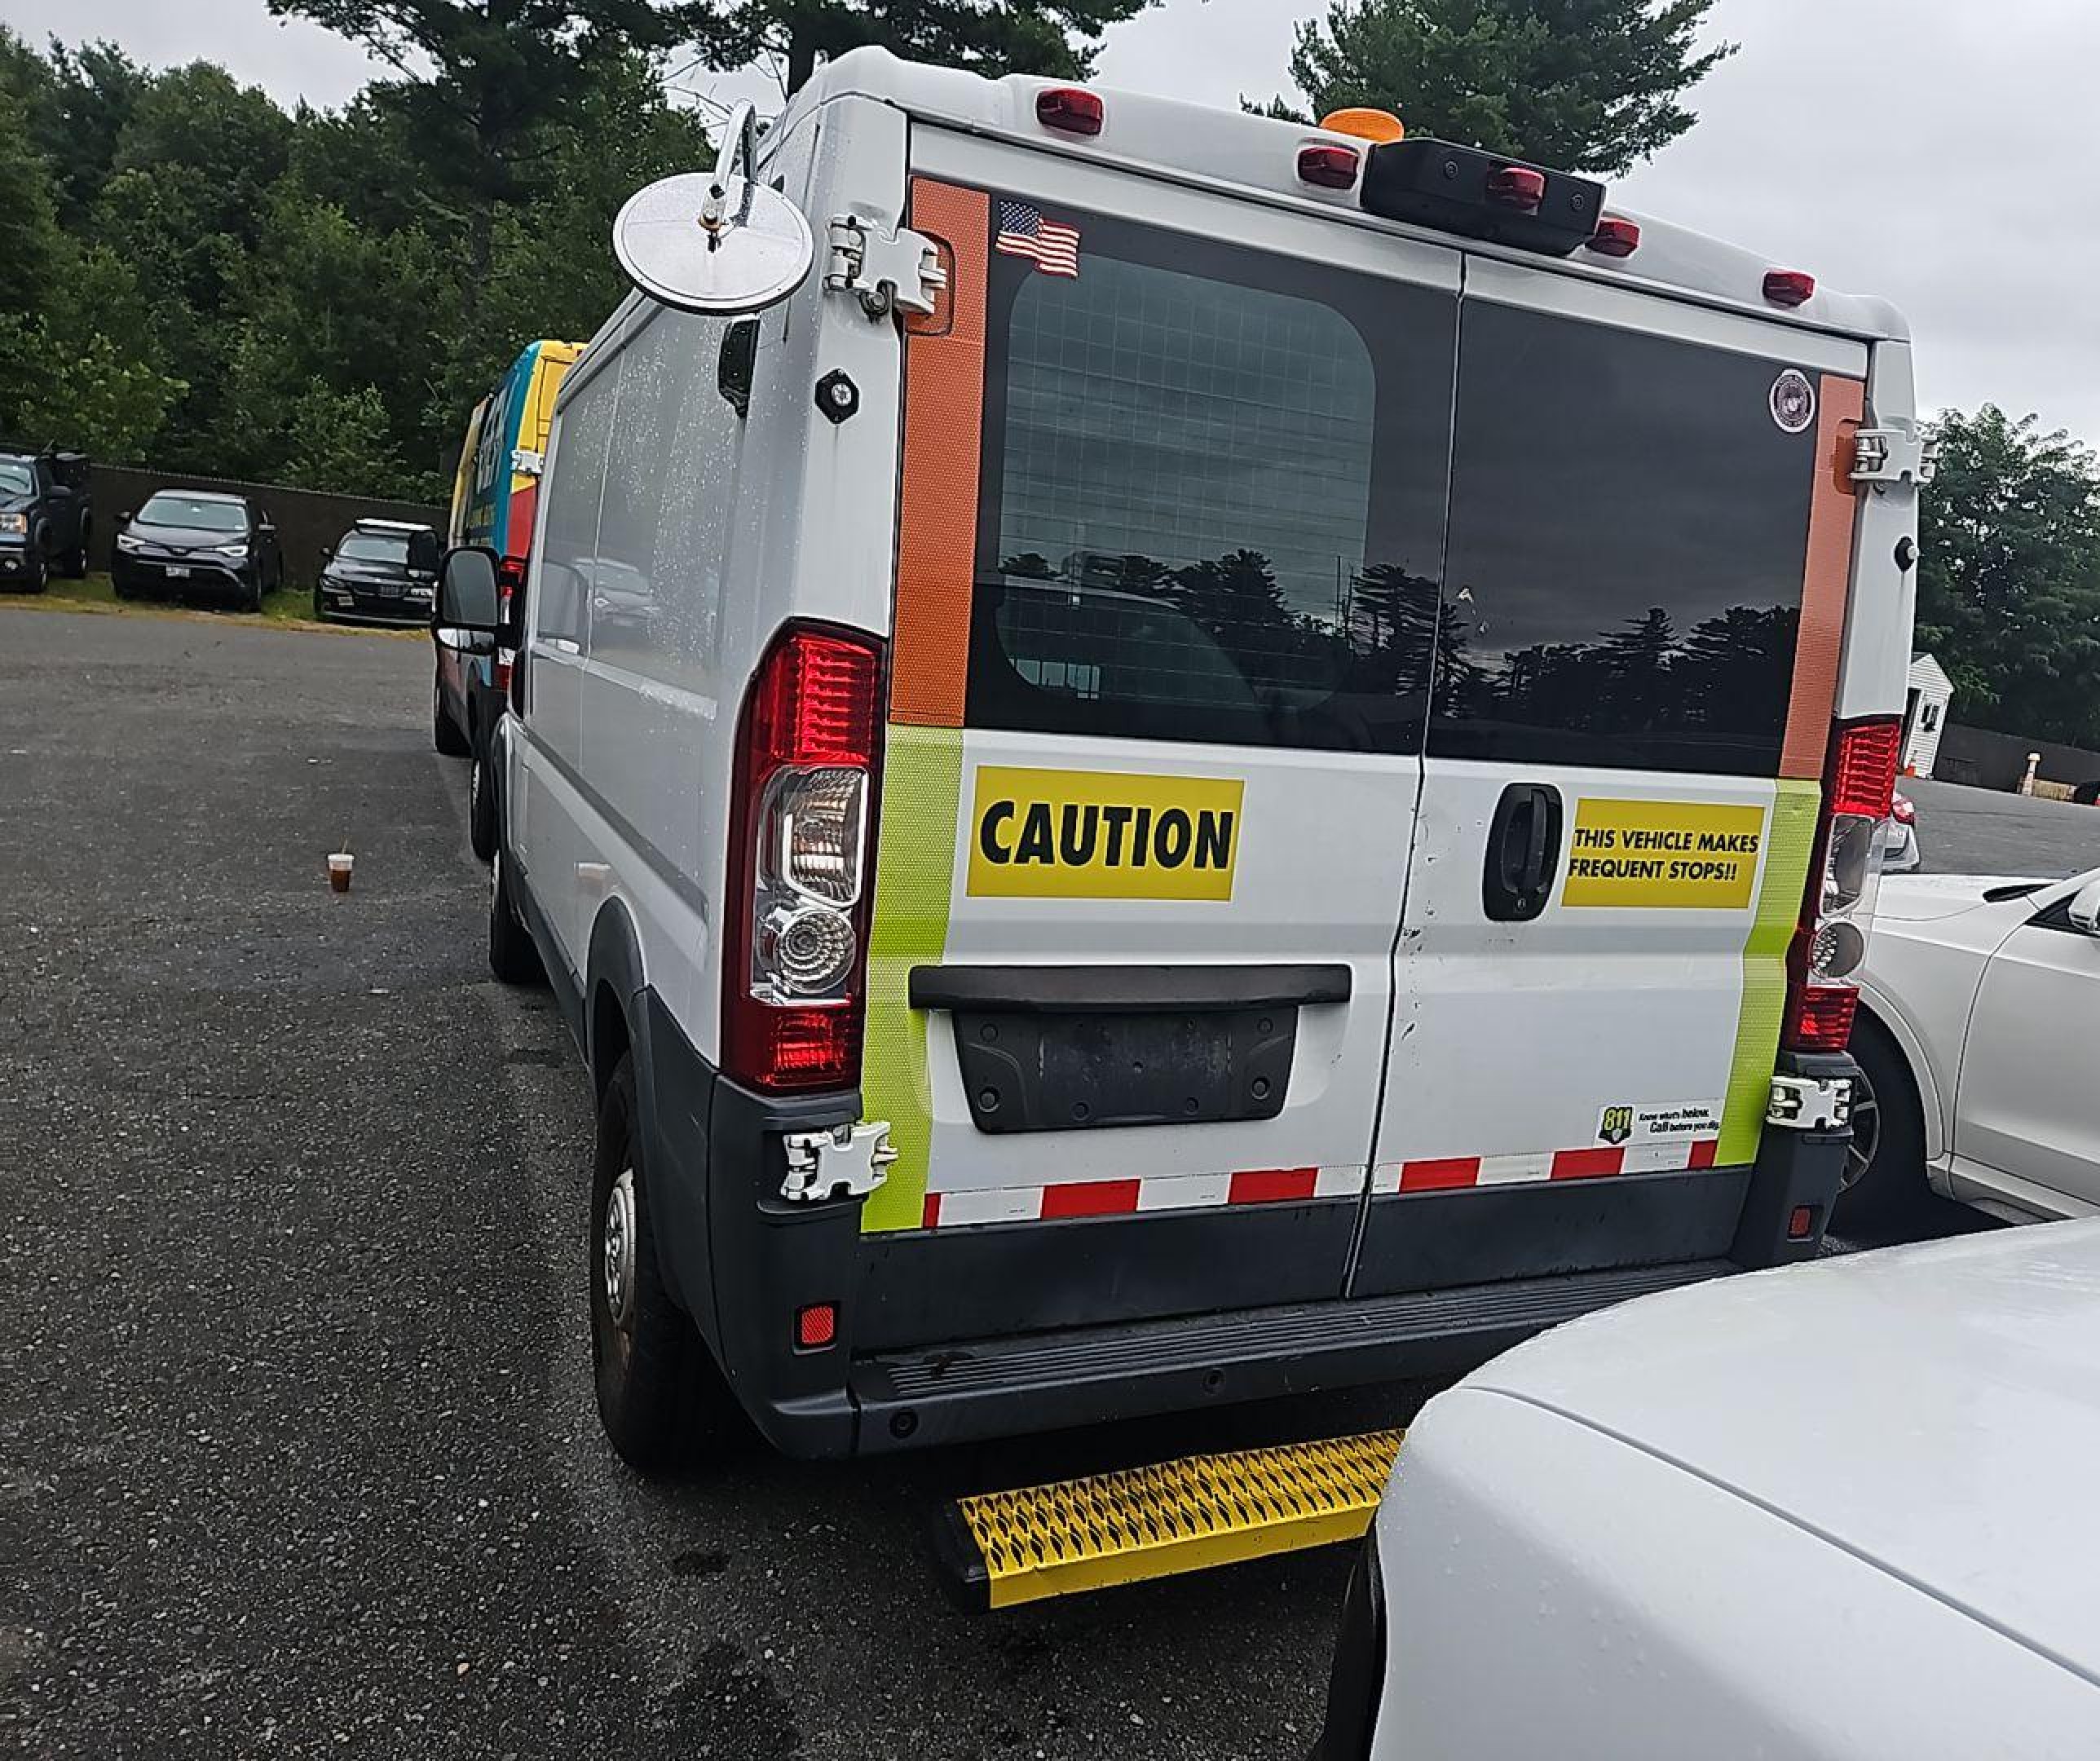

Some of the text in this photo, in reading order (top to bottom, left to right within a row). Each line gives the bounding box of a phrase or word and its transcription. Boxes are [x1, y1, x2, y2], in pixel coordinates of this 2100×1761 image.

[979, 800, 1233, 869] CAUTION
[1574, 828, 1759, 853] THIS VEHICLE MAKES
[1568, 858, 1737, 881] FREQUENT STOPS!!
[1604, 1109, 1631, 1131] 811
